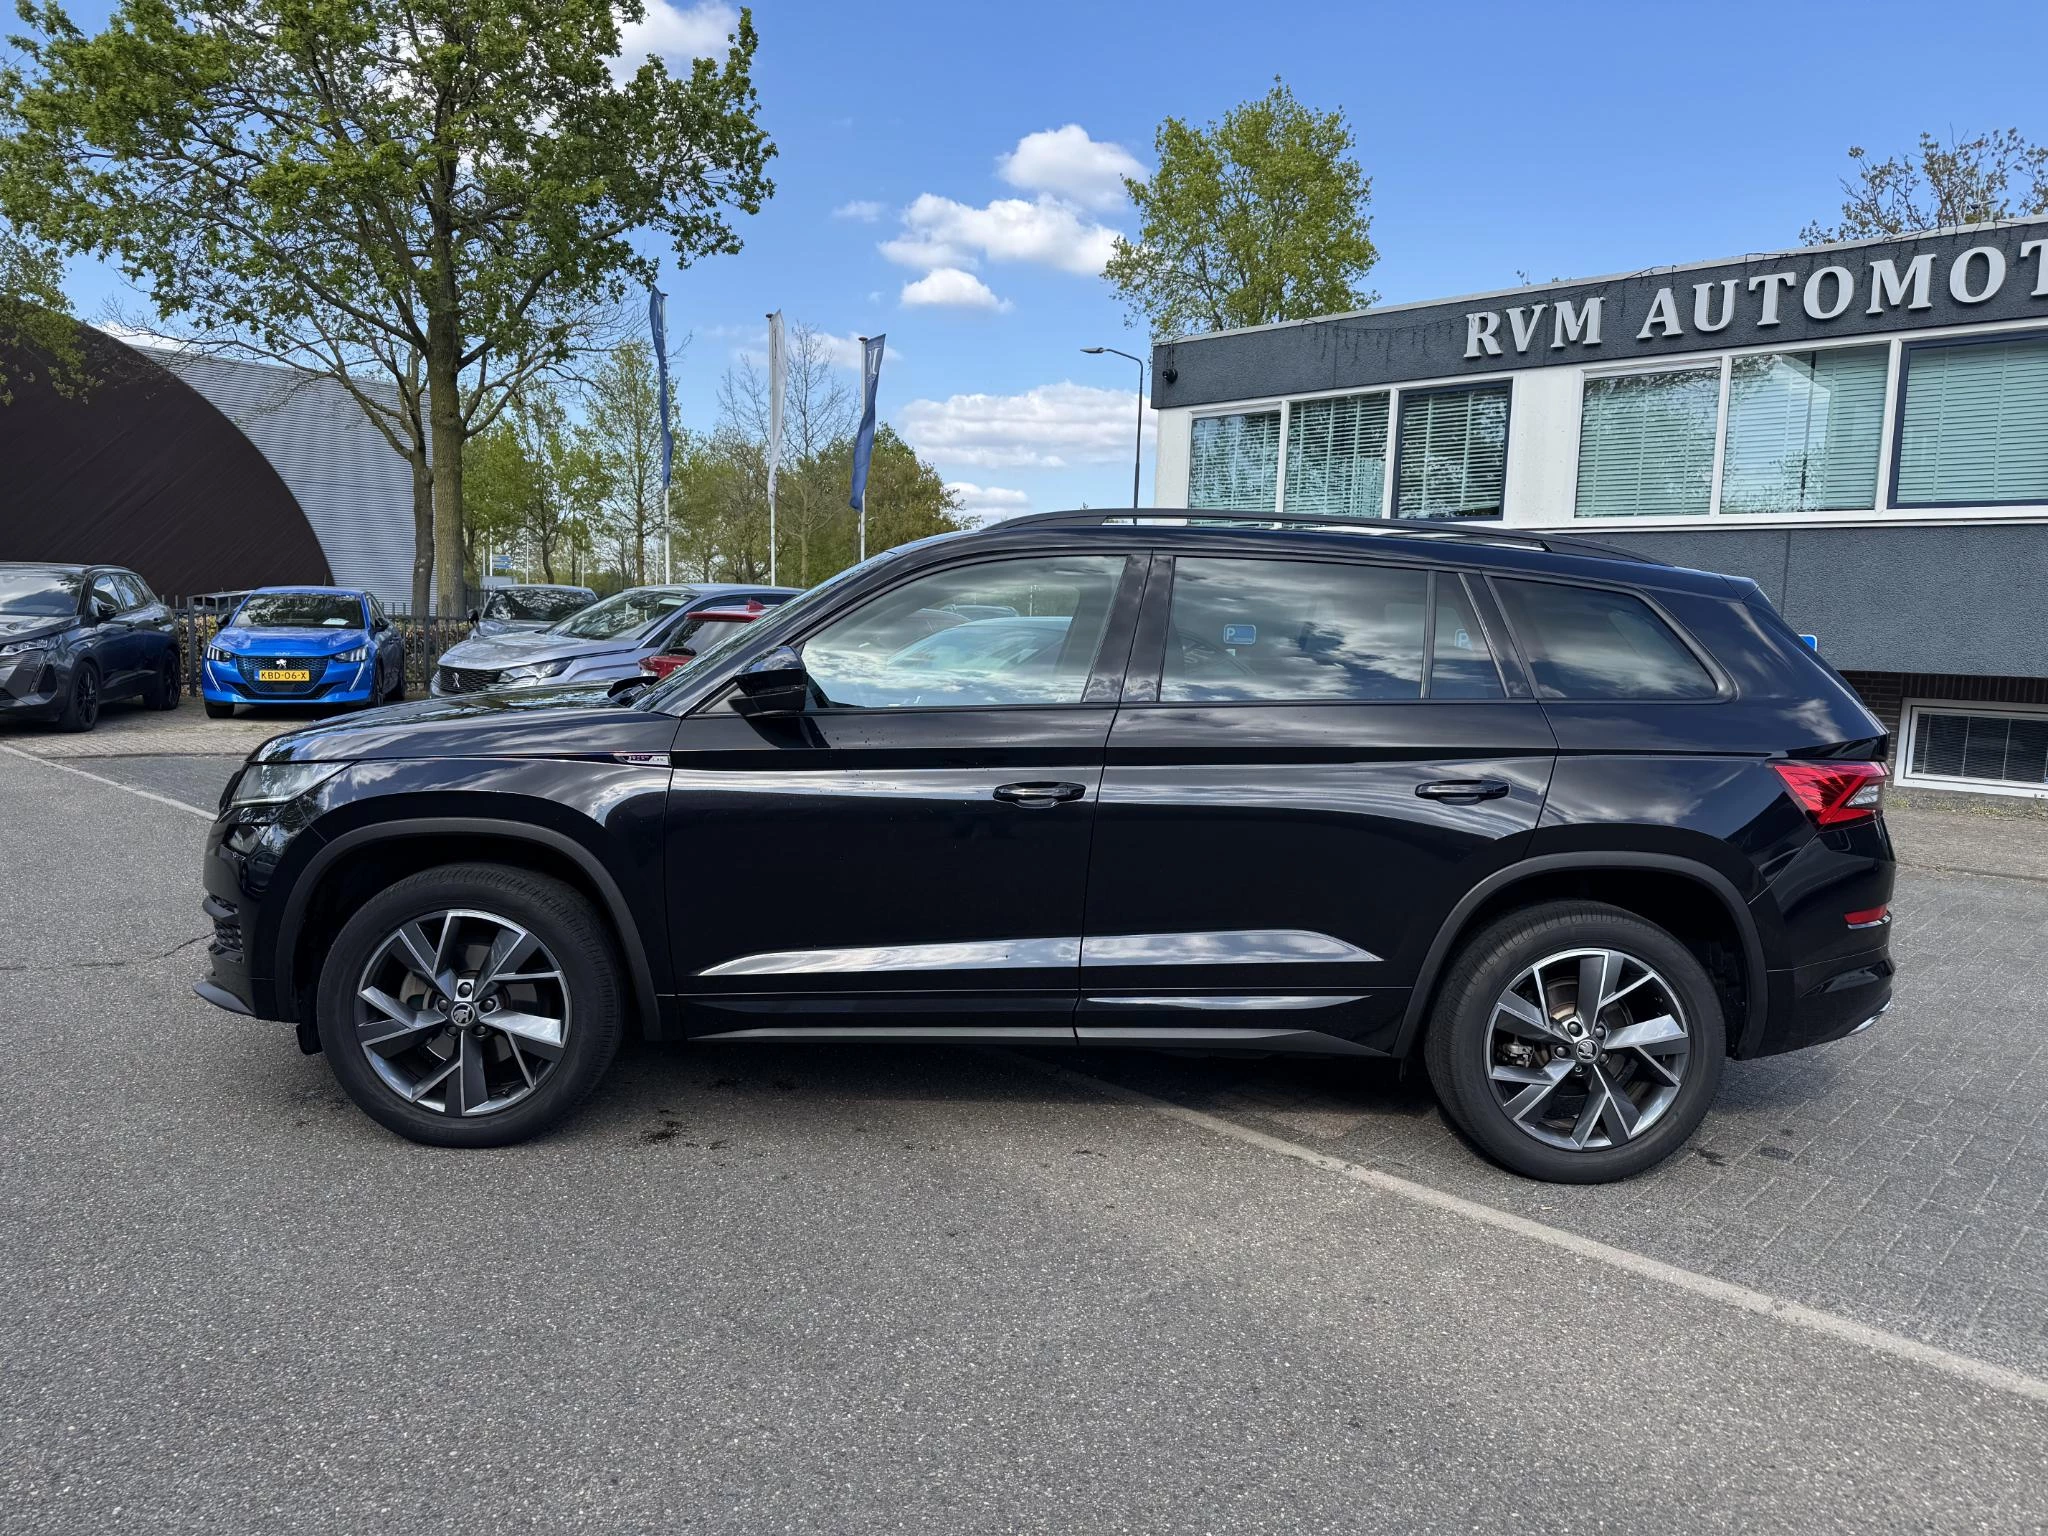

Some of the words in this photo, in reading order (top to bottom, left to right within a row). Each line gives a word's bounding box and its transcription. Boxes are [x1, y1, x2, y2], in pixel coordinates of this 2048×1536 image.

[1464, 297, 1606, 357] RVM
[1226, 627, 1236, 641] P
[261, 671, 307, 680] KBD-06-X
